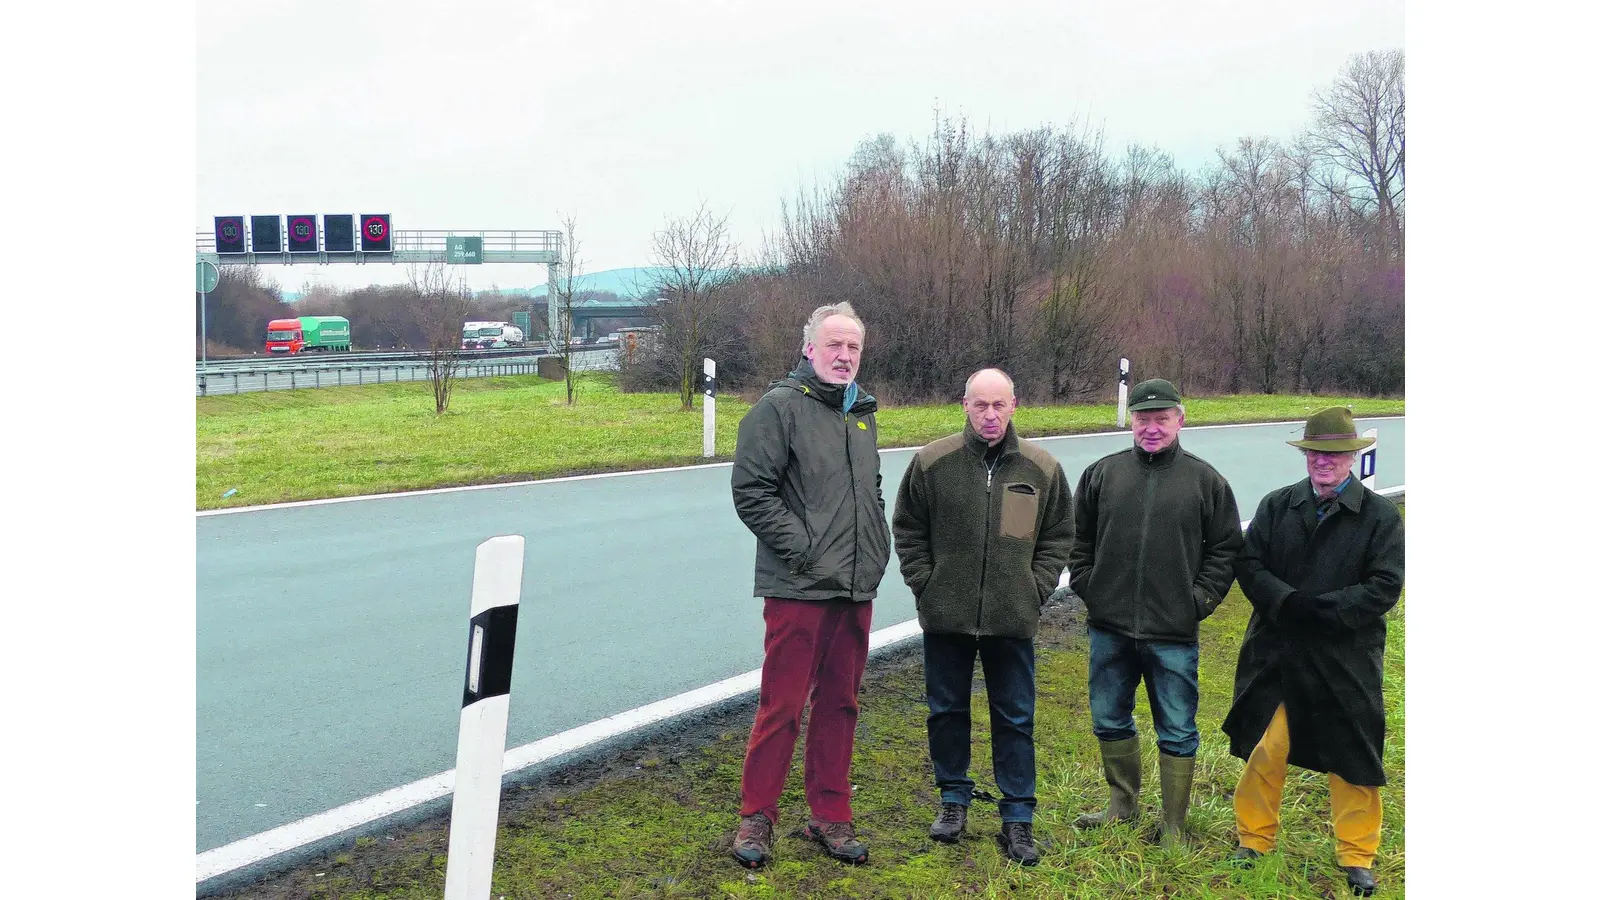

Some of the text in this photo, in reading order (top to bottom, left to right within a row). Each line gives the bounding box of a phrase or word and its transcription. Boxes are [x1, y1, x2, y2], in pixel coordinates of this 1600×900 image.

[223, 226, 237, 237] 130
[295, 225, 309, 236] 130
[368, 224, 383, 235] 130
